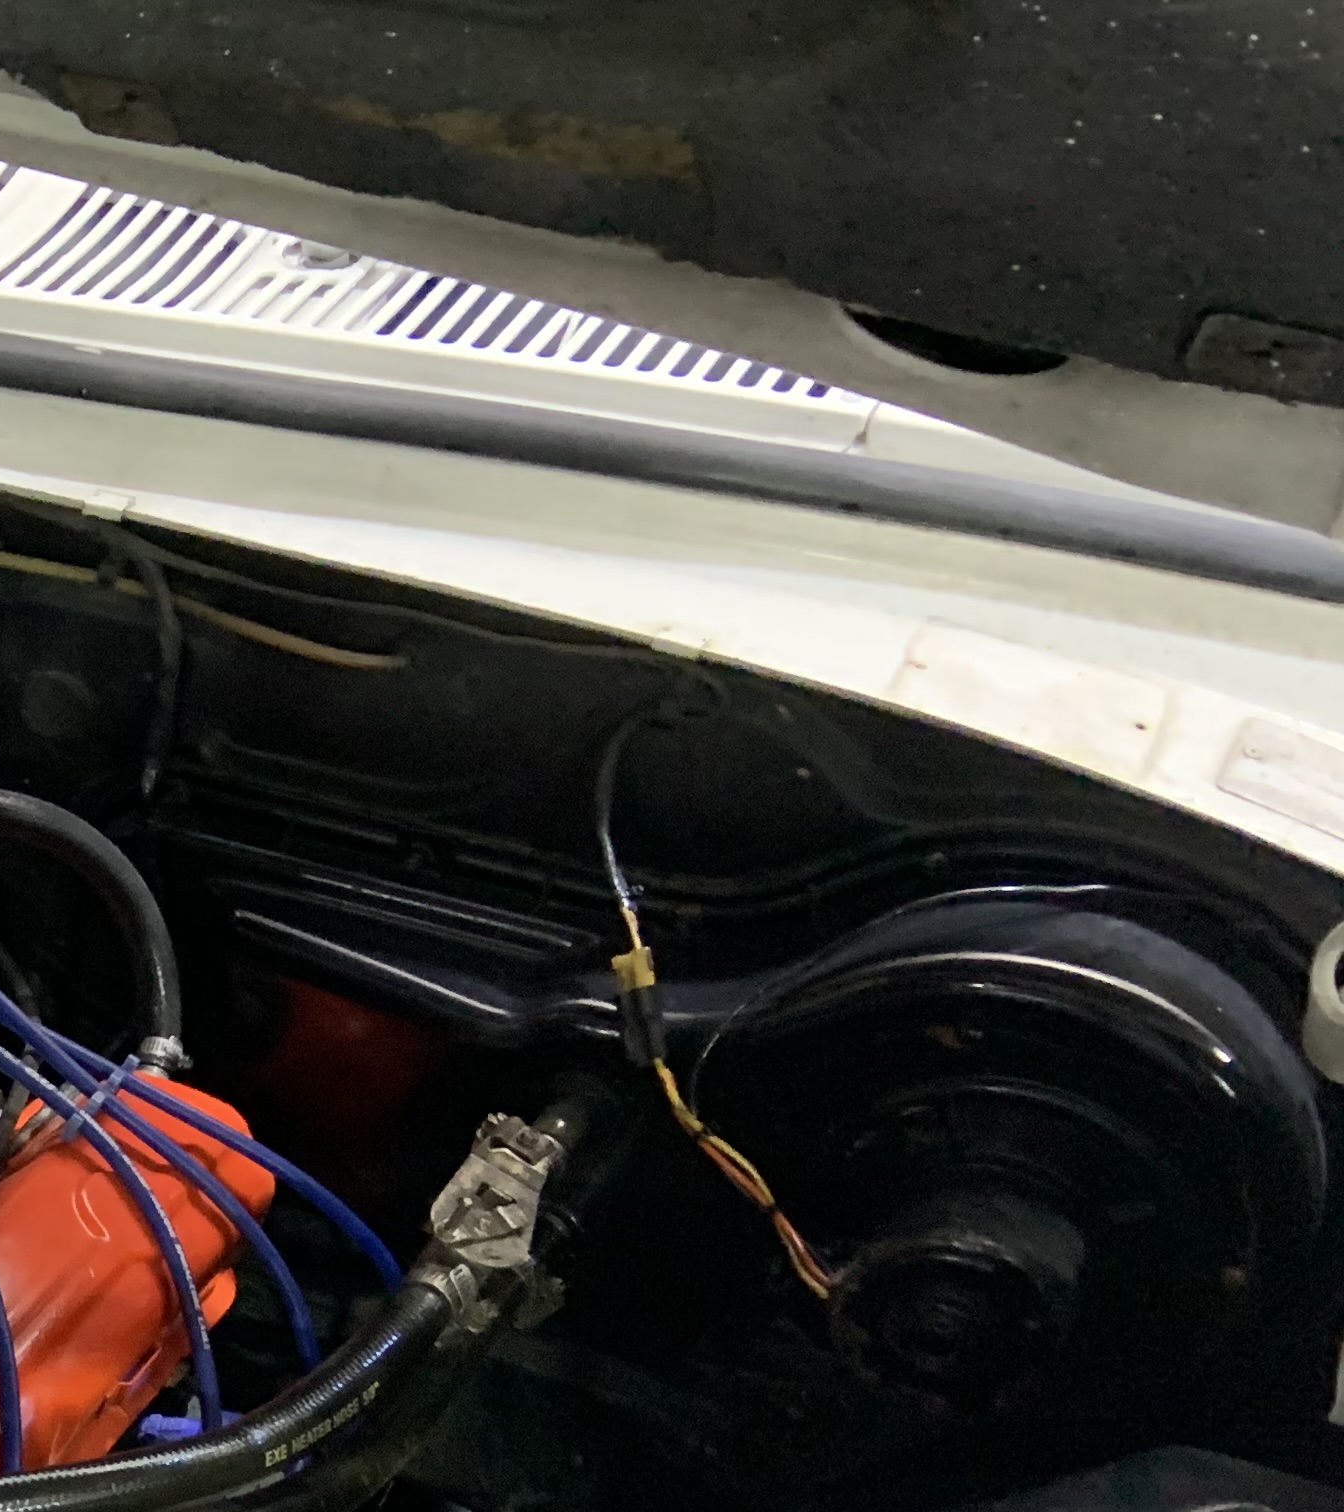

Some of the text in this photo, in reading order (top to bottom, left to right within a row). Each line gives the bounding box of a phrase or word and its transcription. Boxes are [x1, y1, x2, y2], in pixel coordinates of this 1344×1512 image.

[265, 1444, 288, 1468] EXE
[292, 1418, 332, 1454] HEATER
[333, 1397, 360, 1429] HOSE
